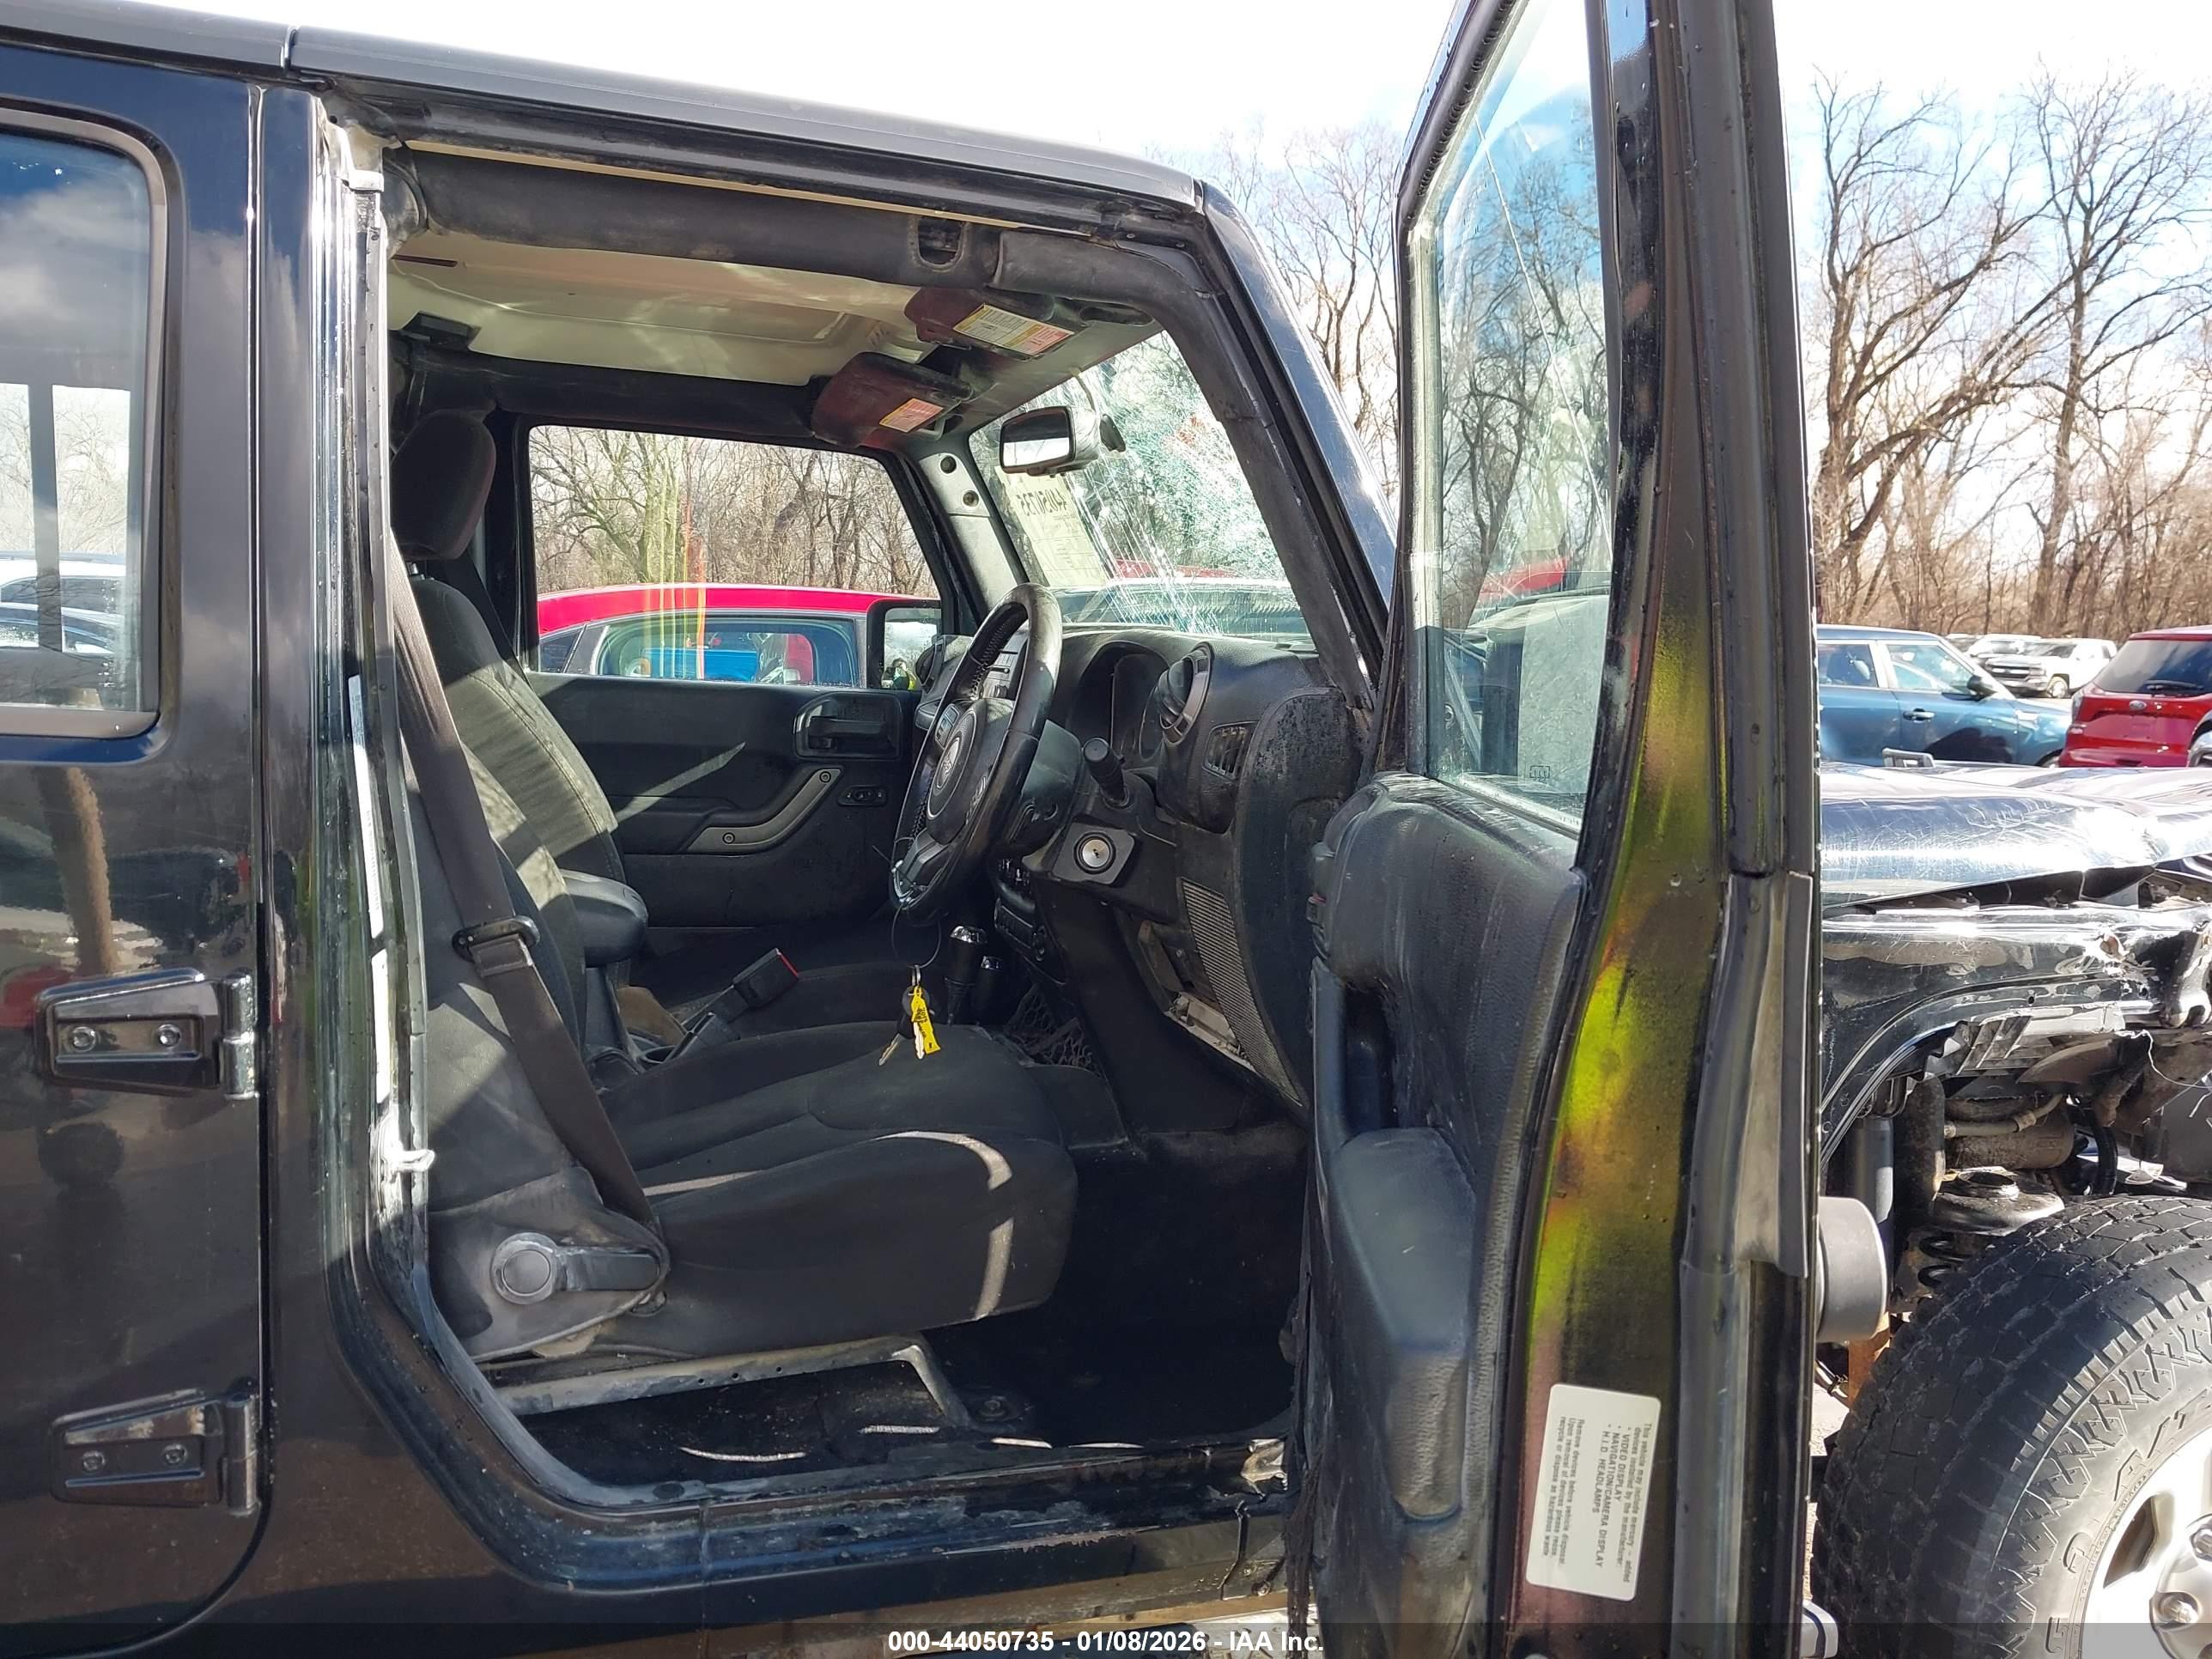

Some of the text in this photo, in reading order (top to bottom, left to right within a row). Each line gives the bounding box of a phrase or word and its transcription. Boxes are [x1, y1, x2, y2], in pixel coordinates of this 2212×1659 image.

[1555, 1415, 1566, 1442] recycle
[1565, 1417, 1577, 1437] Upon
[1573, 1419, 1585, 1448] Remove
[1631, 1426, 1642, 1455] devices
[1642, 1422, 1651, 1438] This
[1562, 1438, 1573, 1468] removal
[1569, 1449, 1580, 1478] devices
[1613, 1433, 1630, 1500] VIDEO DISPLAY
[1638, 1440, 1648, 1467] vehicle
[1550, 1454, 1561, 1482] dispose
[1560, 1469, 1569, 1478] of
[1626, 1456, 1638, 1489] installed
[1634, 1468, 1644, 1485] may
[1550, 1484, 1557, 1493] as
[1557, 1479, 1567, 1506] devices
[1566, 1480, 1577, 1503] before
[1591, 1457, 1607, 1514] HEADLAMPS
[1594, 1431, 1620, 1567] NAVIGATION/CAMERA DISPLAY
[1623, 1490, 1633, 1500] by
[1623, 1501, 1632, 1514] the
[1632, 1486, 1642, 1514] include
[1545, 1495, 1556, 1533] hazardous
[1553, 1509, 1563, 1533] please
[1562, 1504, 1572, 1531] vehicle
[1626, 1516, 1638, 1547] mercury
[1622, 1559, 1632, 1583] added
